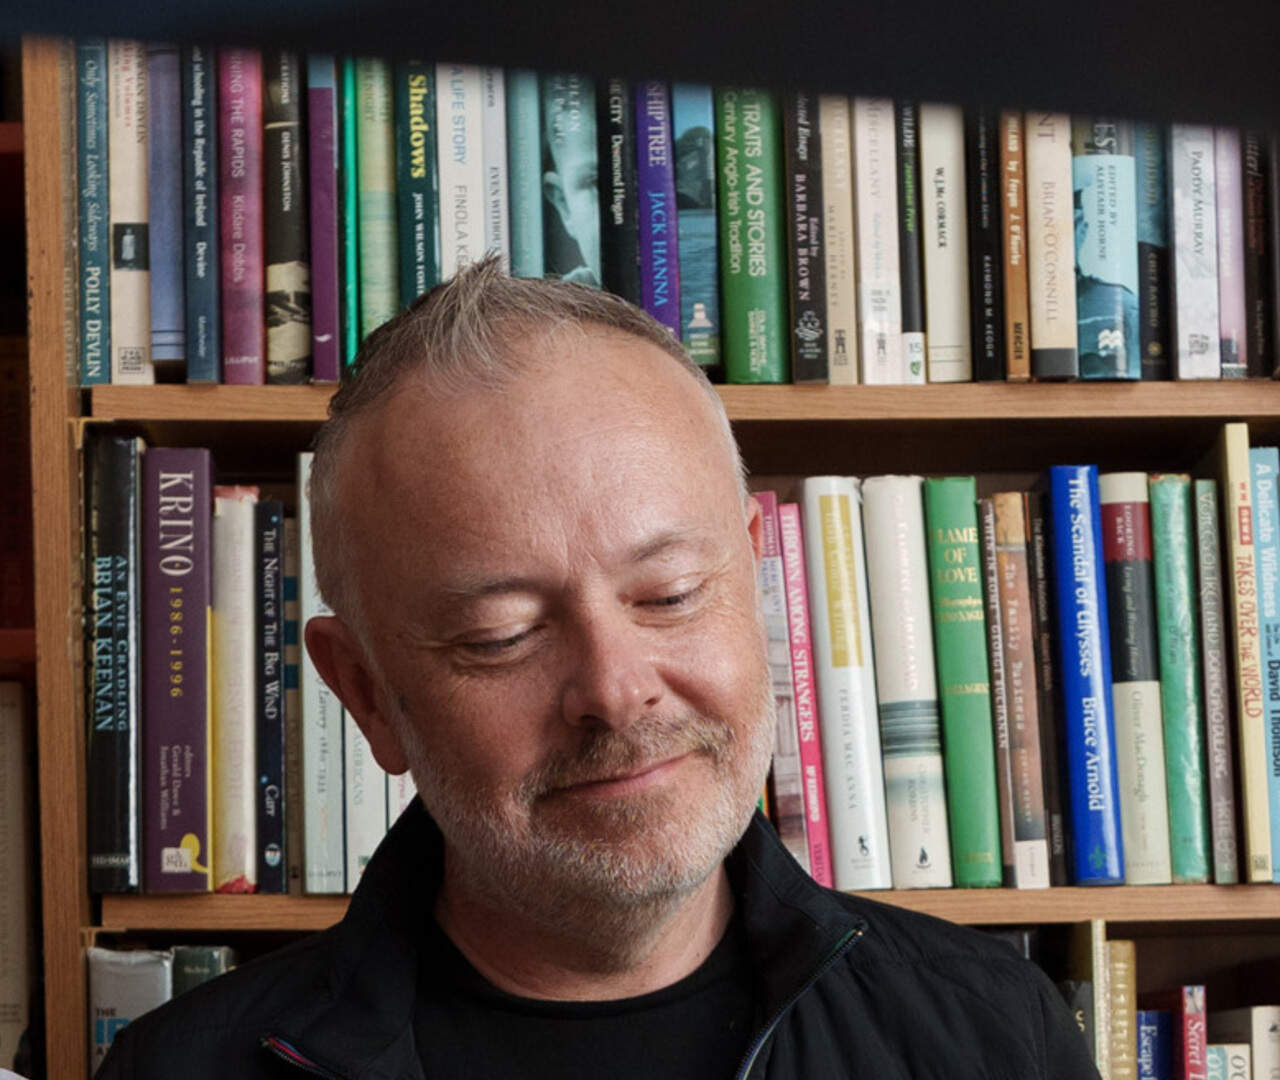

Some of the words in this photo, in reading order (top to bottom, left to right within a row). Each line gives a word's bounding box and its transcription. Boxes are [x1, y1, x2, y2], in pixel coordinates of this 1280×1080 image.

[82, 61, 100, 93] Only
[450, 79, 466, 109] LIFE
[85, 94, 102, 150] Sometimes
[193, 121, 206, 136] the
[231, 99, 245, 123] THE
[408, 75, 430, 178] Shadows
[723, 93, 740, 142] Century
[743, 104, 763, 157] TRAITS
[193, 139, 208, 177] Republic
[231, 128, 246, 179] RAPIDS
[452, 114, 467, 165] STORY
[612, 133, 626, 187] Desmond
[648, 125, 669, 167] TREE
[82, 155, 102, 198] Looking
[281, 162, 295, 212] JOHNSTON
[725, 147, 743, 217] Anglo-Irish
[745, 164, 765, 204] AND
[1191, 151, 1204, 195] PADDY
[82, 202, 103, 252] Sideways
[195, 193, 208, 227] Ireland
[232, 194, 246, 239] Kildare
[412, 192, 424, 219] JOHN
[454, 184, 468, 240] FINOLA
[610, 188, 627, 225] Hogan
[650, 191, 669, 235] JACK
[795, 173, 810, 241] BARBARA
[1041, 181, 1057, 229] BRIAN
[195, 241, 209, 278] Devine
[233, 243, 247, 283] Dobbs
[414, 223, 425, 262] WILSON
[728, 219, 744, 275] Tradition
[747, 209, 767, 276] STORIES
[85, 265, 101, 312] POLLY
[650, 240, 670, 307] HANNA
[798, 247, 812, 301] BROWN
[1042, 233, 1061, 324] O'CONNELL
[86, 319, 102, 377] DEVLIN
[1067, 477, 1087, 509] The
[1255, 463, 1271, 475] A
[158, 470, 195, 577] KRINO
[1123, 504, 1136, 556] LOOKING
[1256, 479, 1274, 543] Delicate
[263, 528, 277, 551] THE
[779, 514, 801, 582] THROWN
[1069, 513, 1093, 581] Scandal
[94, 555, 113, 627] BRIAN
[116, 555, 129, 580] AN
[262, 556, 279, 599] NIGHT
[936, 567, 979, 586] LOVE
[1235, 553, 1255, 598] TAKES
[1260, 546, 1279, 618] Wildness
[116, 592, 130, 632] EVIL
[786, 586, 808, 645] AMONG
[1074, 587, 1094, 607] of
[1238, 600, 1259, 637] OVER
[169, 586, 184, 698] 1986-1996
[263, 621, 278, 645] THE
[1073, 610, 1095, 677] Ulysses
[1240, 641, 1253, 663] THE
[94, 637, 114, 733] KEENAN
[116, 640, 130, 732] CRADLING
[264, 651, 280, 676] BIG
[264, 681, 280, 719] WIND
[791, 649, 816, 743] STRANGERS
[1241, 665, 1264, 718] WORLD
[1081, 696, 1099, 747] Bruce
[1084, 751, 1104, 811] Arnold
[1136, 1025, 1158, 1076] Escape
[1187, 1019, 1205, 1073] Secret
